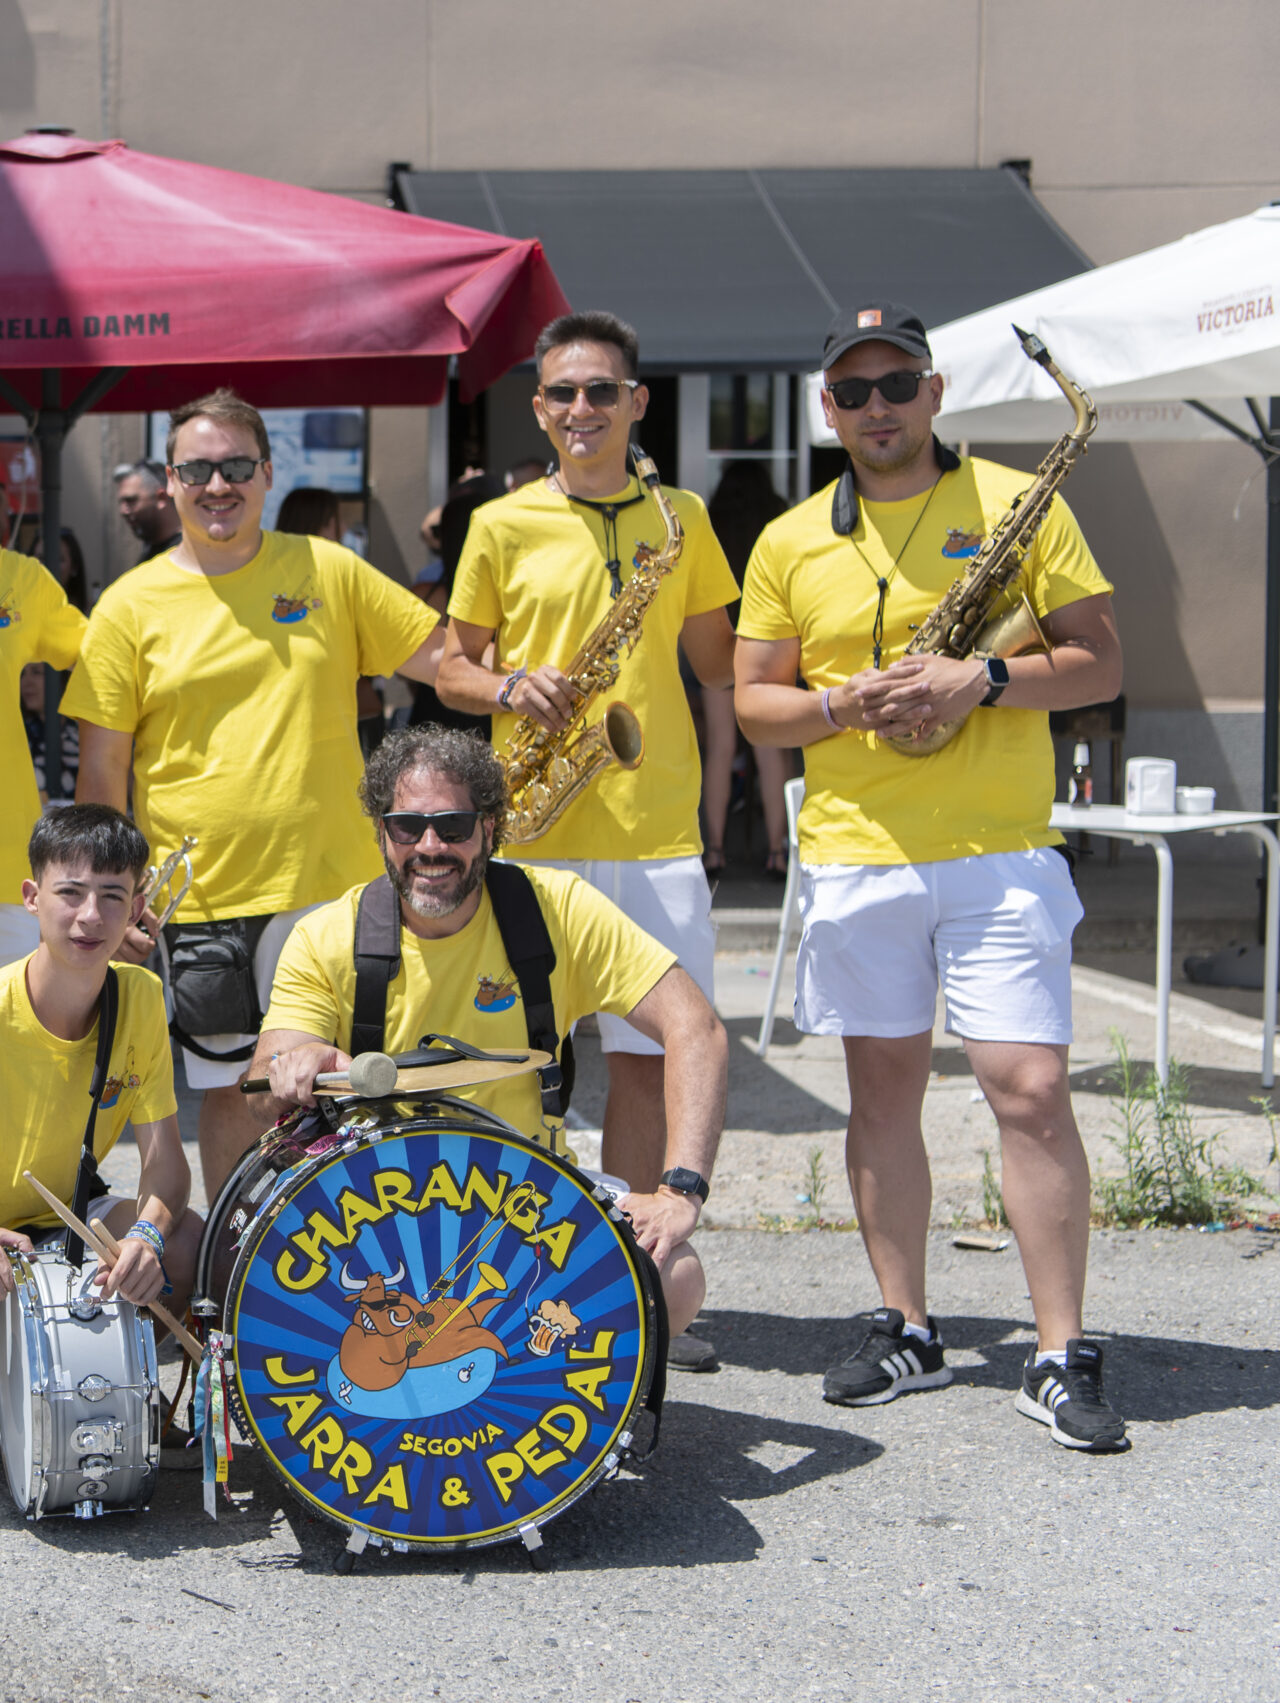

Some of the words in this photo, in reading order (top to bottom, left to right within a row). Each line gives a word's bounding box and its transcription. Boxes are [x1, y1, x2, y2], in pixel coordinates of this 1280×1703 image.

[83, 312, 170, 339] DAMM
[1196, 294, 1275, 334] VICTORIA
[275, 1162, 578, 1292] CHARANGA
[264, 1355, 410, 1511] JARRA
[441, 1477, 470, 1507] &
[486, 1330, 616, 1503] PEDAL
[398, 1421, 505, 1457] SEGOVIA
